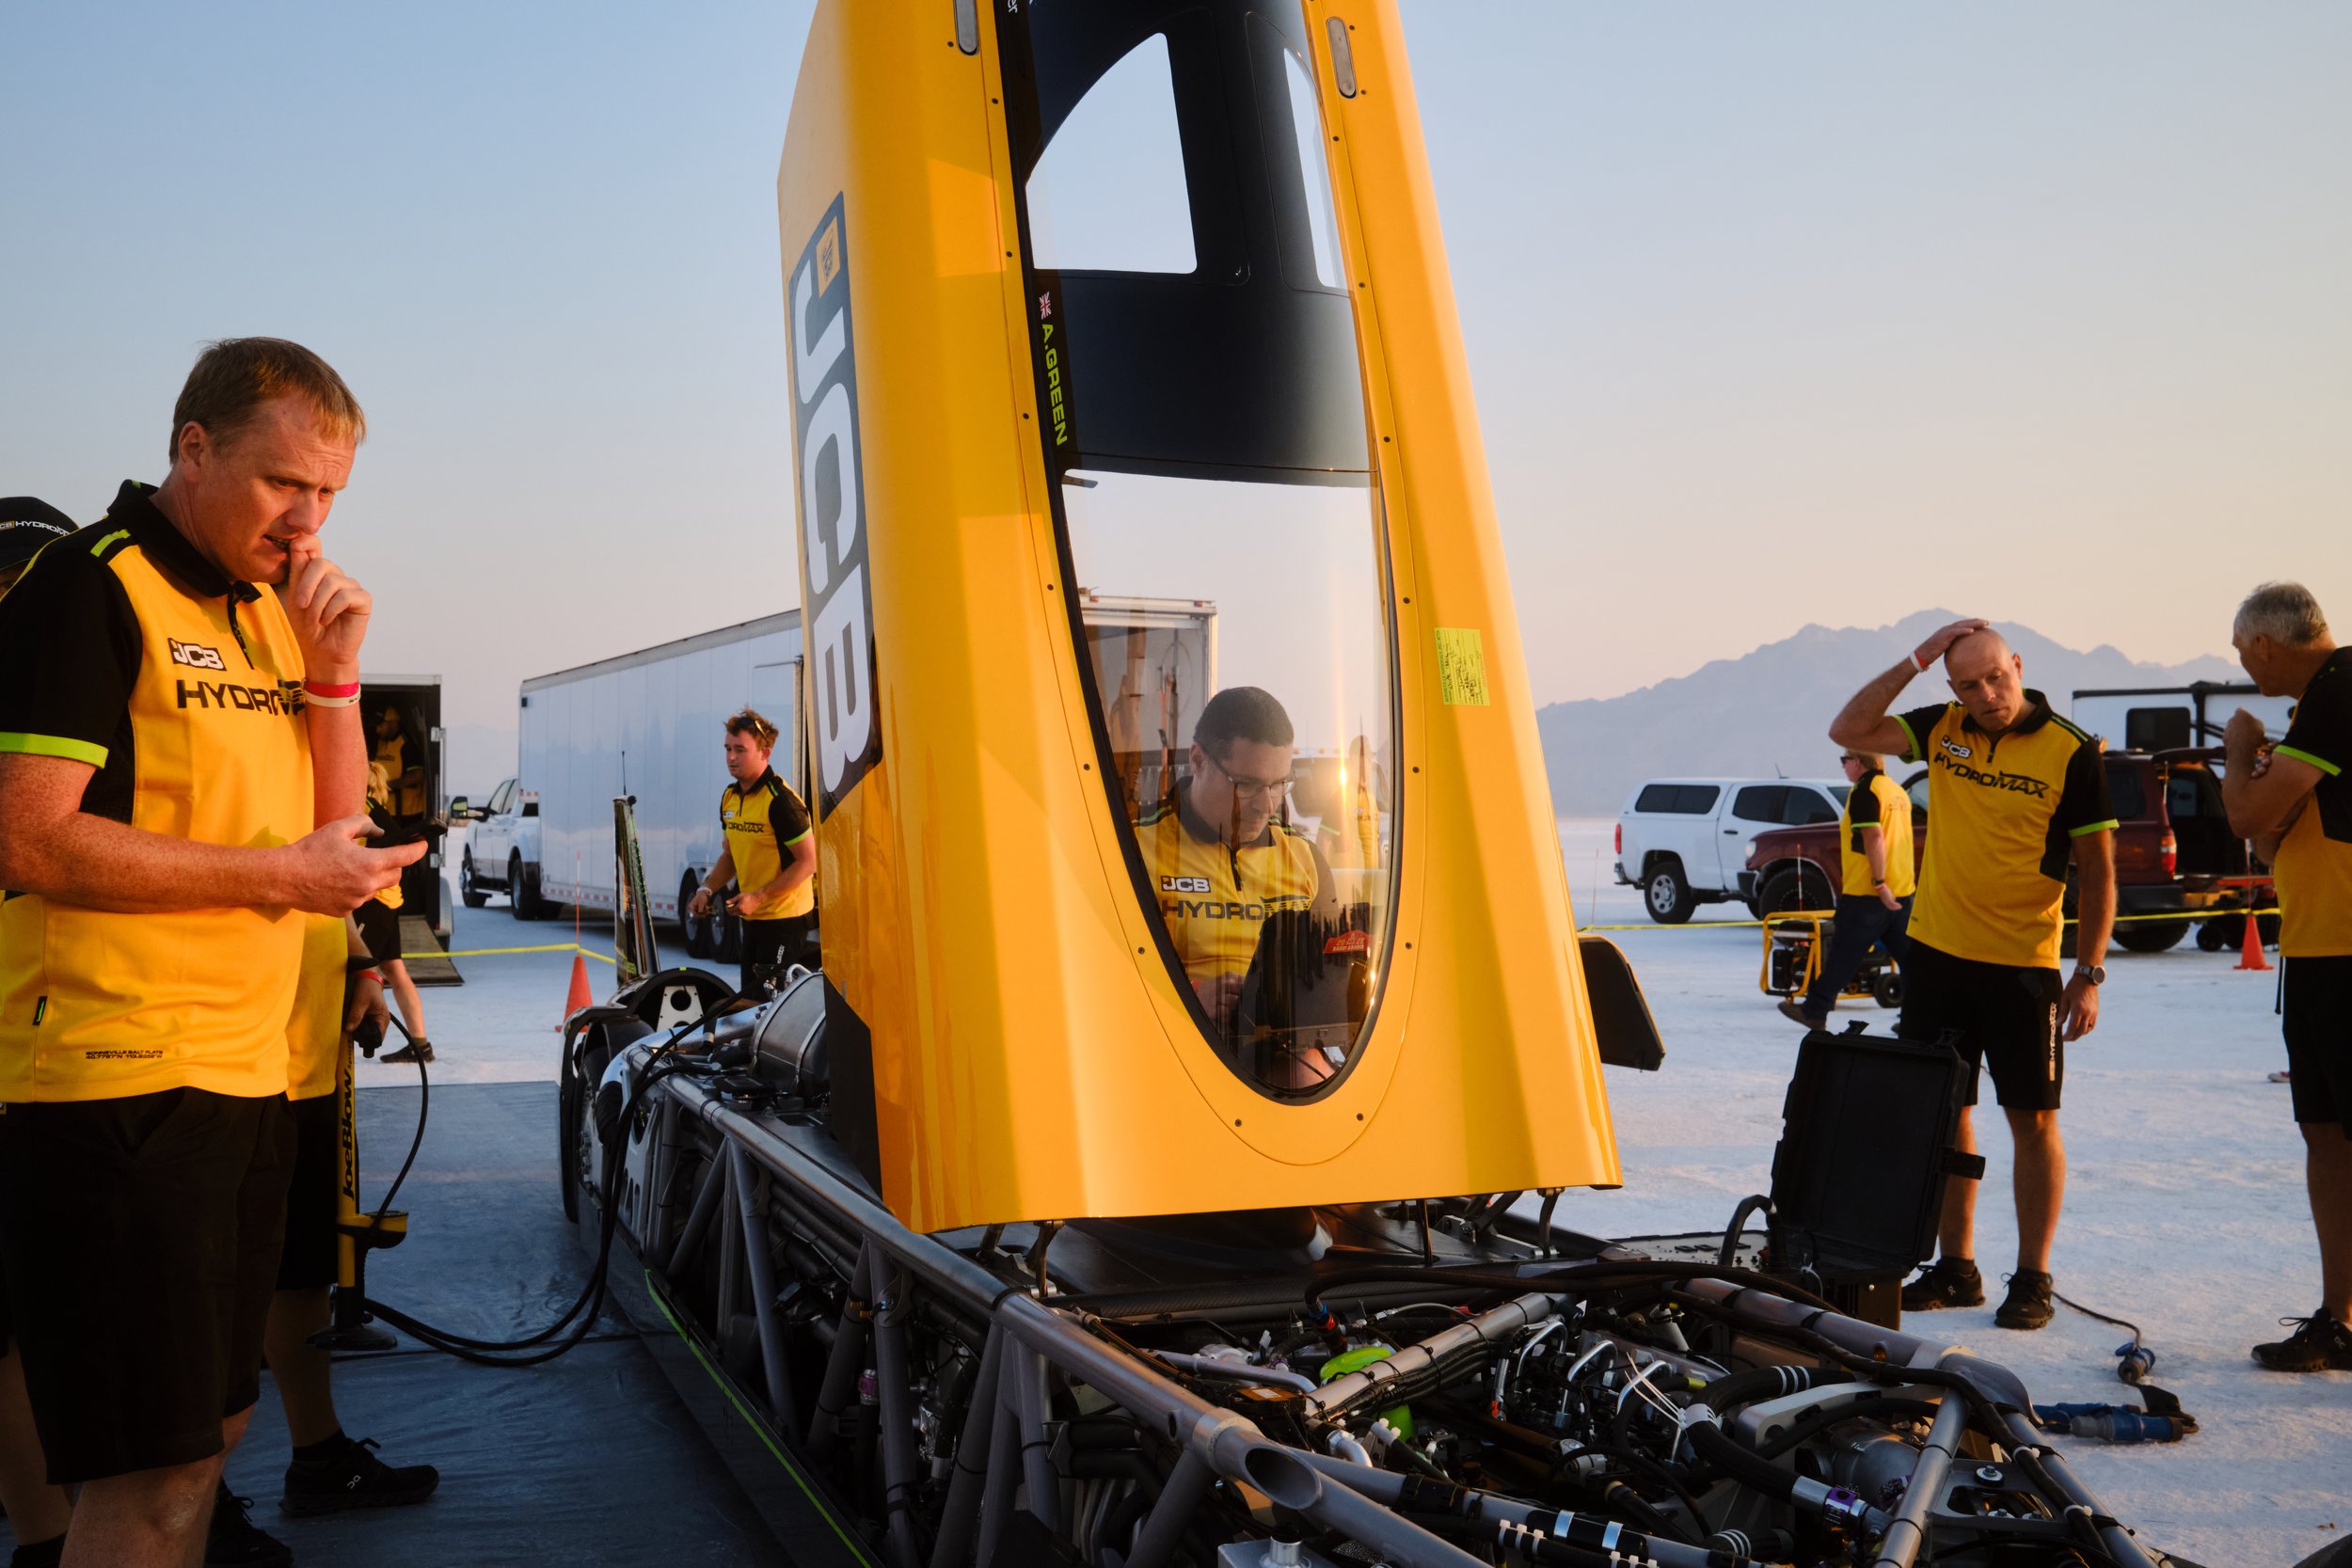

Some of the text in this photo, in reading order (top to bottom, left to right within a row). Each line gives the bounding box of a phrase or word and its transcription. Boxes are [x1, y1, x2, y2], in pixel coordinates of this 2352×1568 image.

[1041, 324, 1068, 447] A.GREEN
[795, 259, 871, 793] JCB
[172, 641, 225, 671] JCB
[1941, 736, 1972, 759] JCB
[1933, 752, 2049, 799] HYDROMAX
[1162, 876, 1210, 893] JCB
[342, 1069, 354, 1201] JoeBlow
